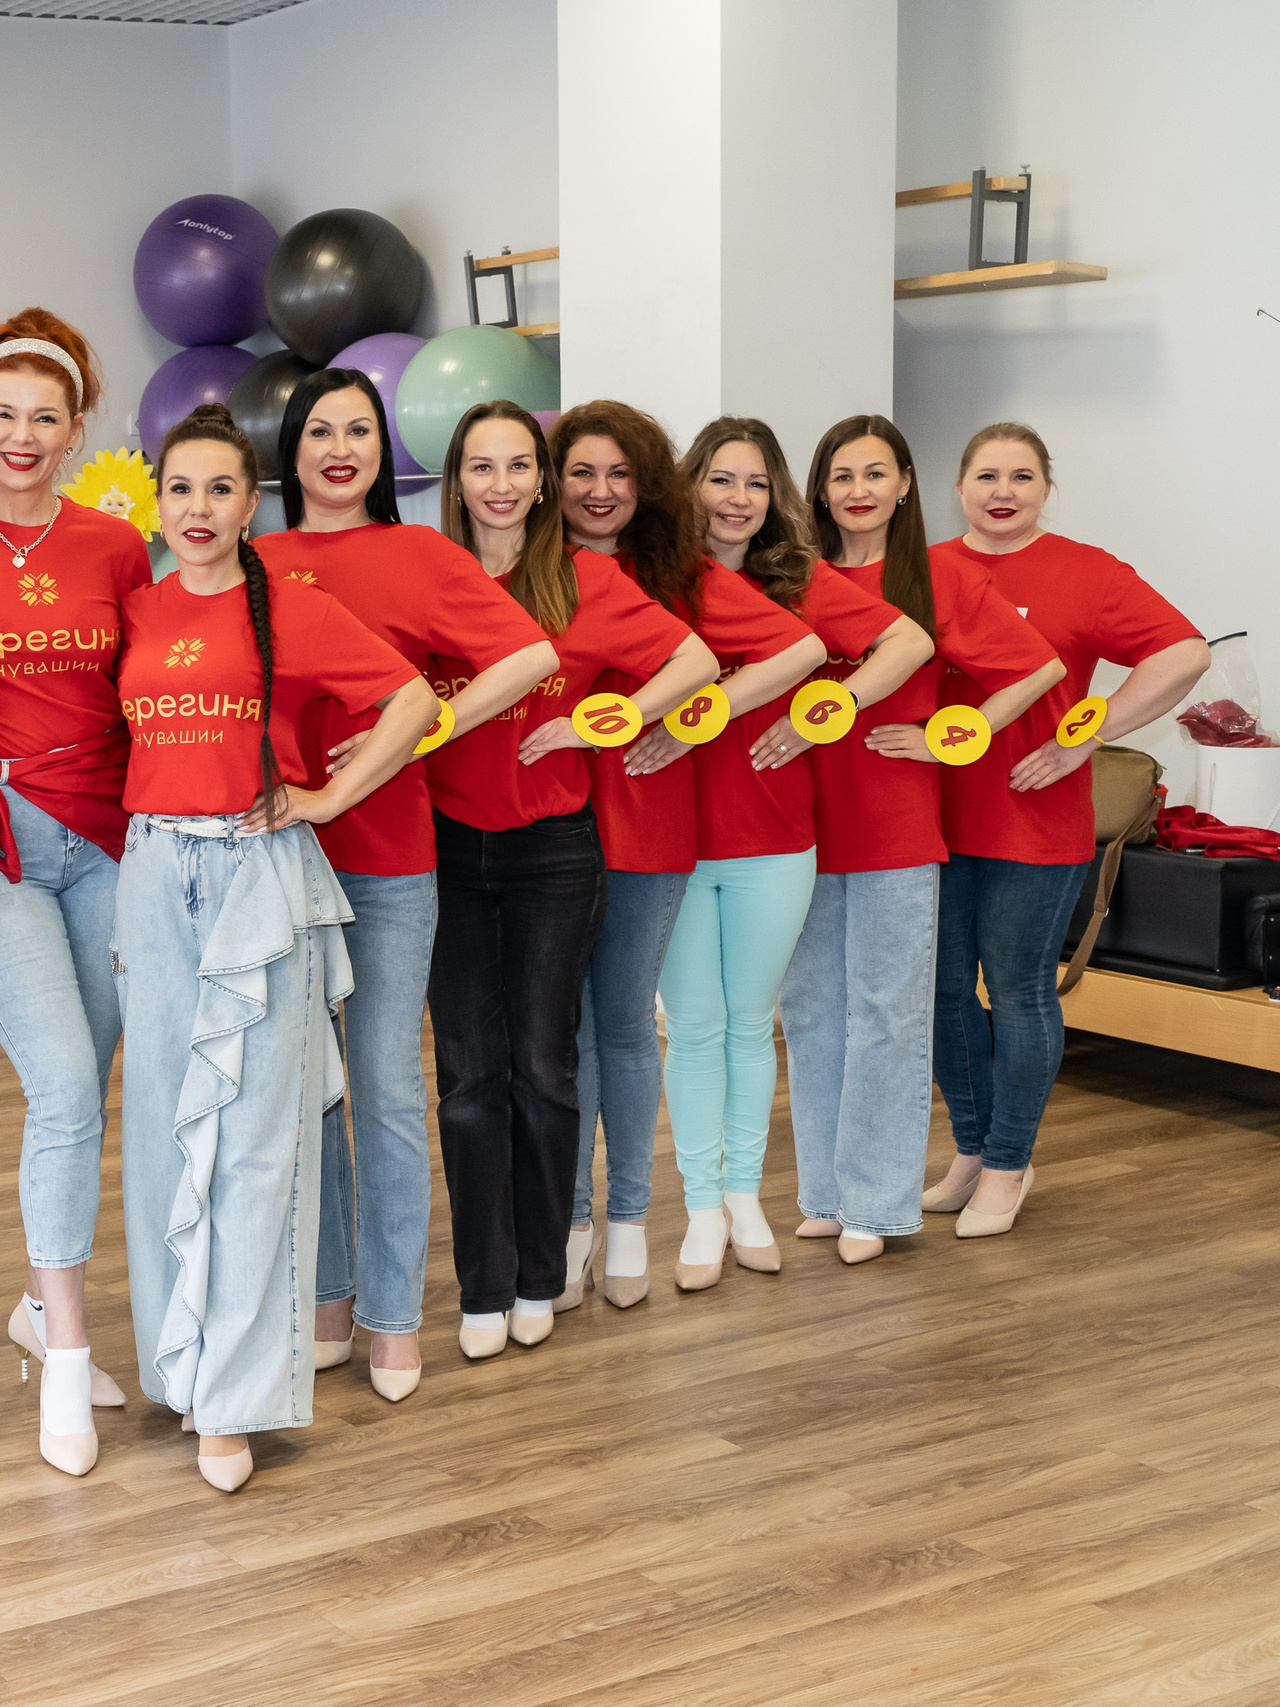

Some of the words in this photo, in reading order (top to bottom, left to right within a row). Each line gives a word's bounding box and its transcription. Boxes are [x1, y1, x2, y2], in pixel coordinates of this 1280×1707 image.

[122, 693, 262, 726] ерегиня
[583, 702, 630, 735] 10
[679, 696, 713, 727] 8
[804, 699, 842, 726] 6
[1066, 709, 1096, 737] 2
[133, 730, 224, 748] чувашии
[940, 725, 977, 747] 4
